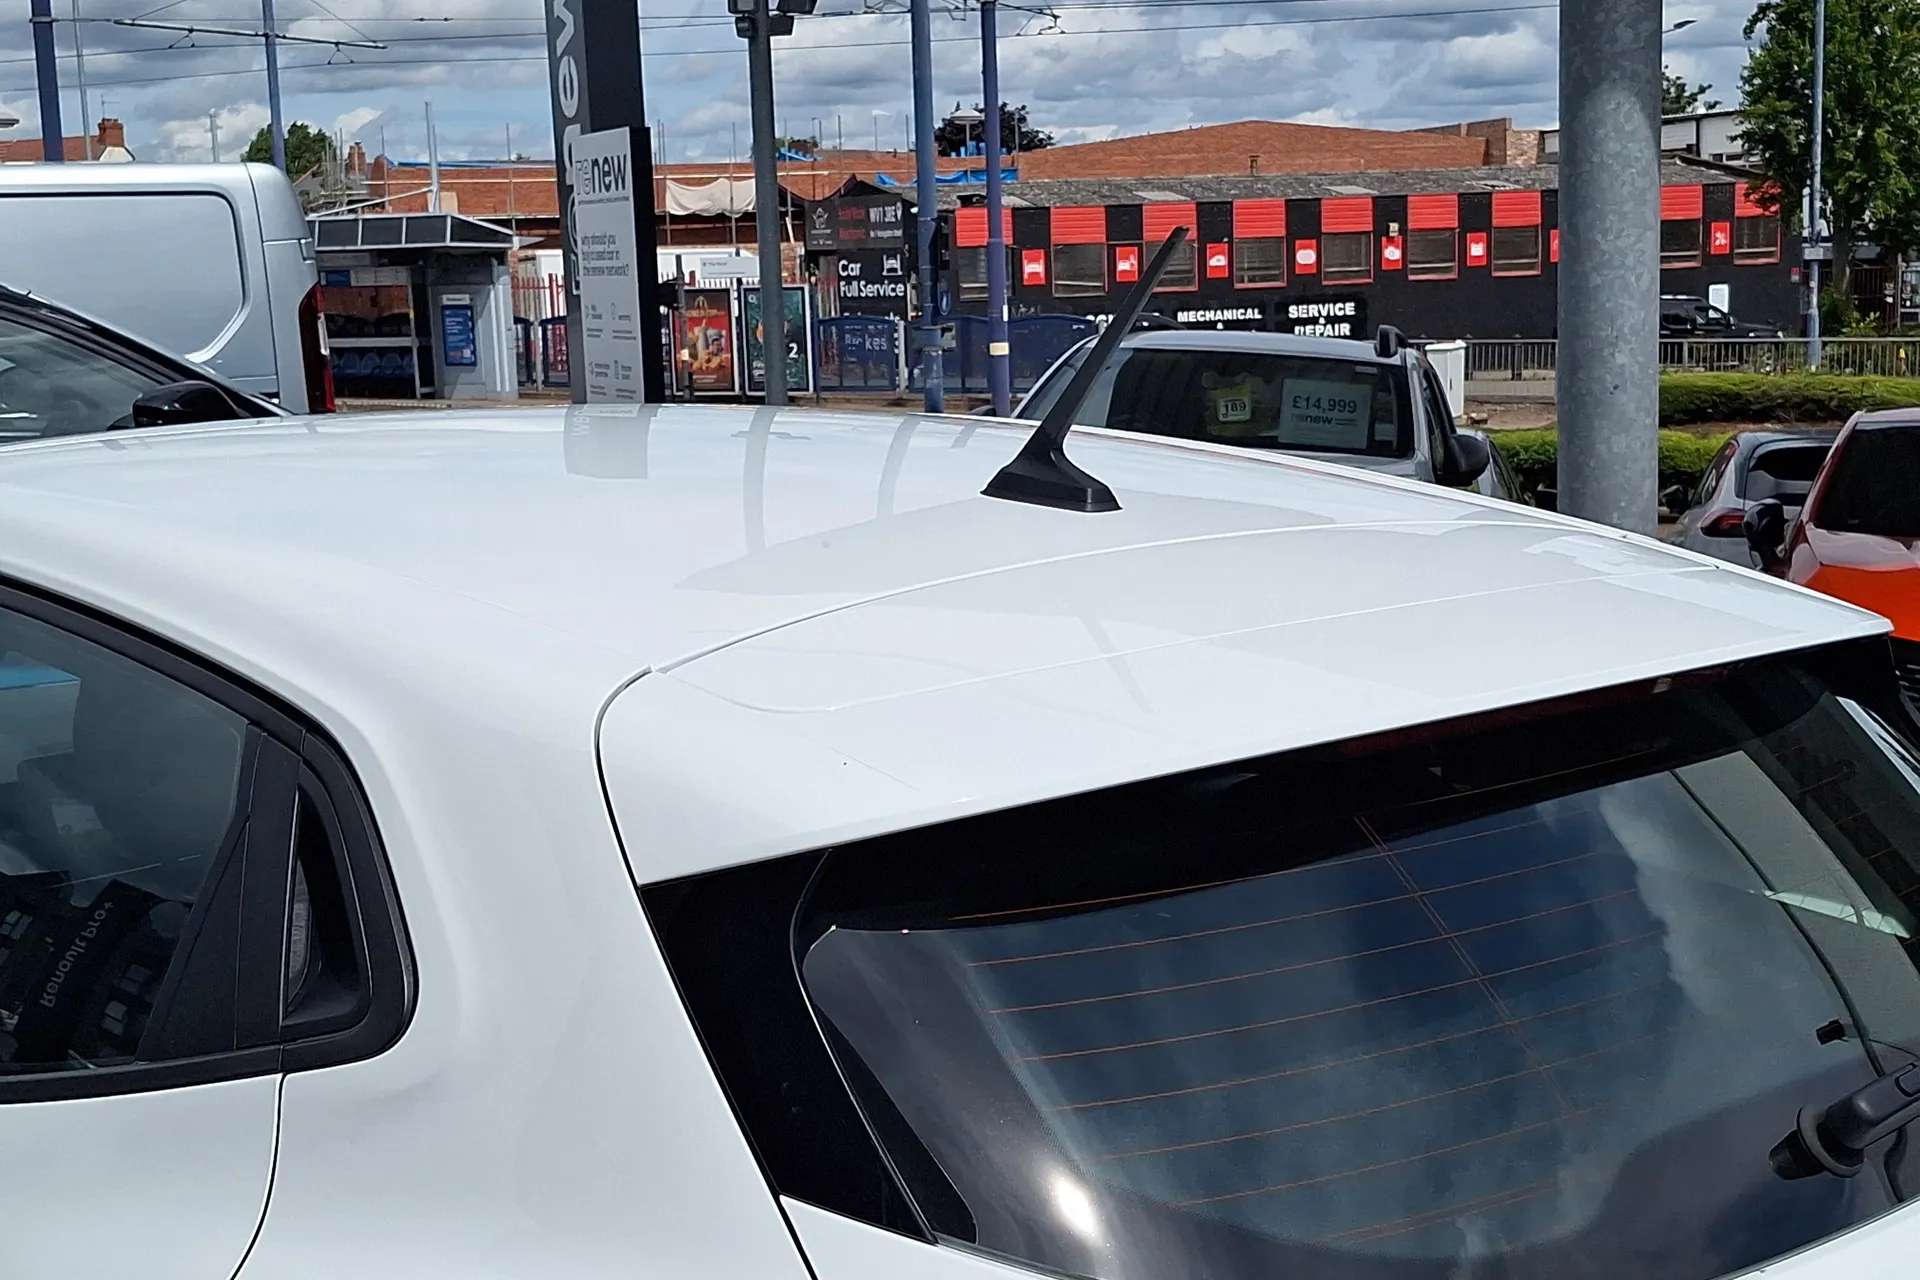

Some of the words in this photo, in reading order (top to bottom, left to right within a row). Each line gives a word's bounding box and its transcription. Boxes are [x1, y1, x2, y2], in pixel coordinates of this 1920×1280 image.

[839, 260, 861, 276] Car
[840, 281, 859, 297] Full
[860, 279, 905, 297] Service
[1177, 308, 1263, 322] MECHANICAL
[1289, 302, 1355, 318] SERVICE
[1292, 395, 1358, 414] £14,999
